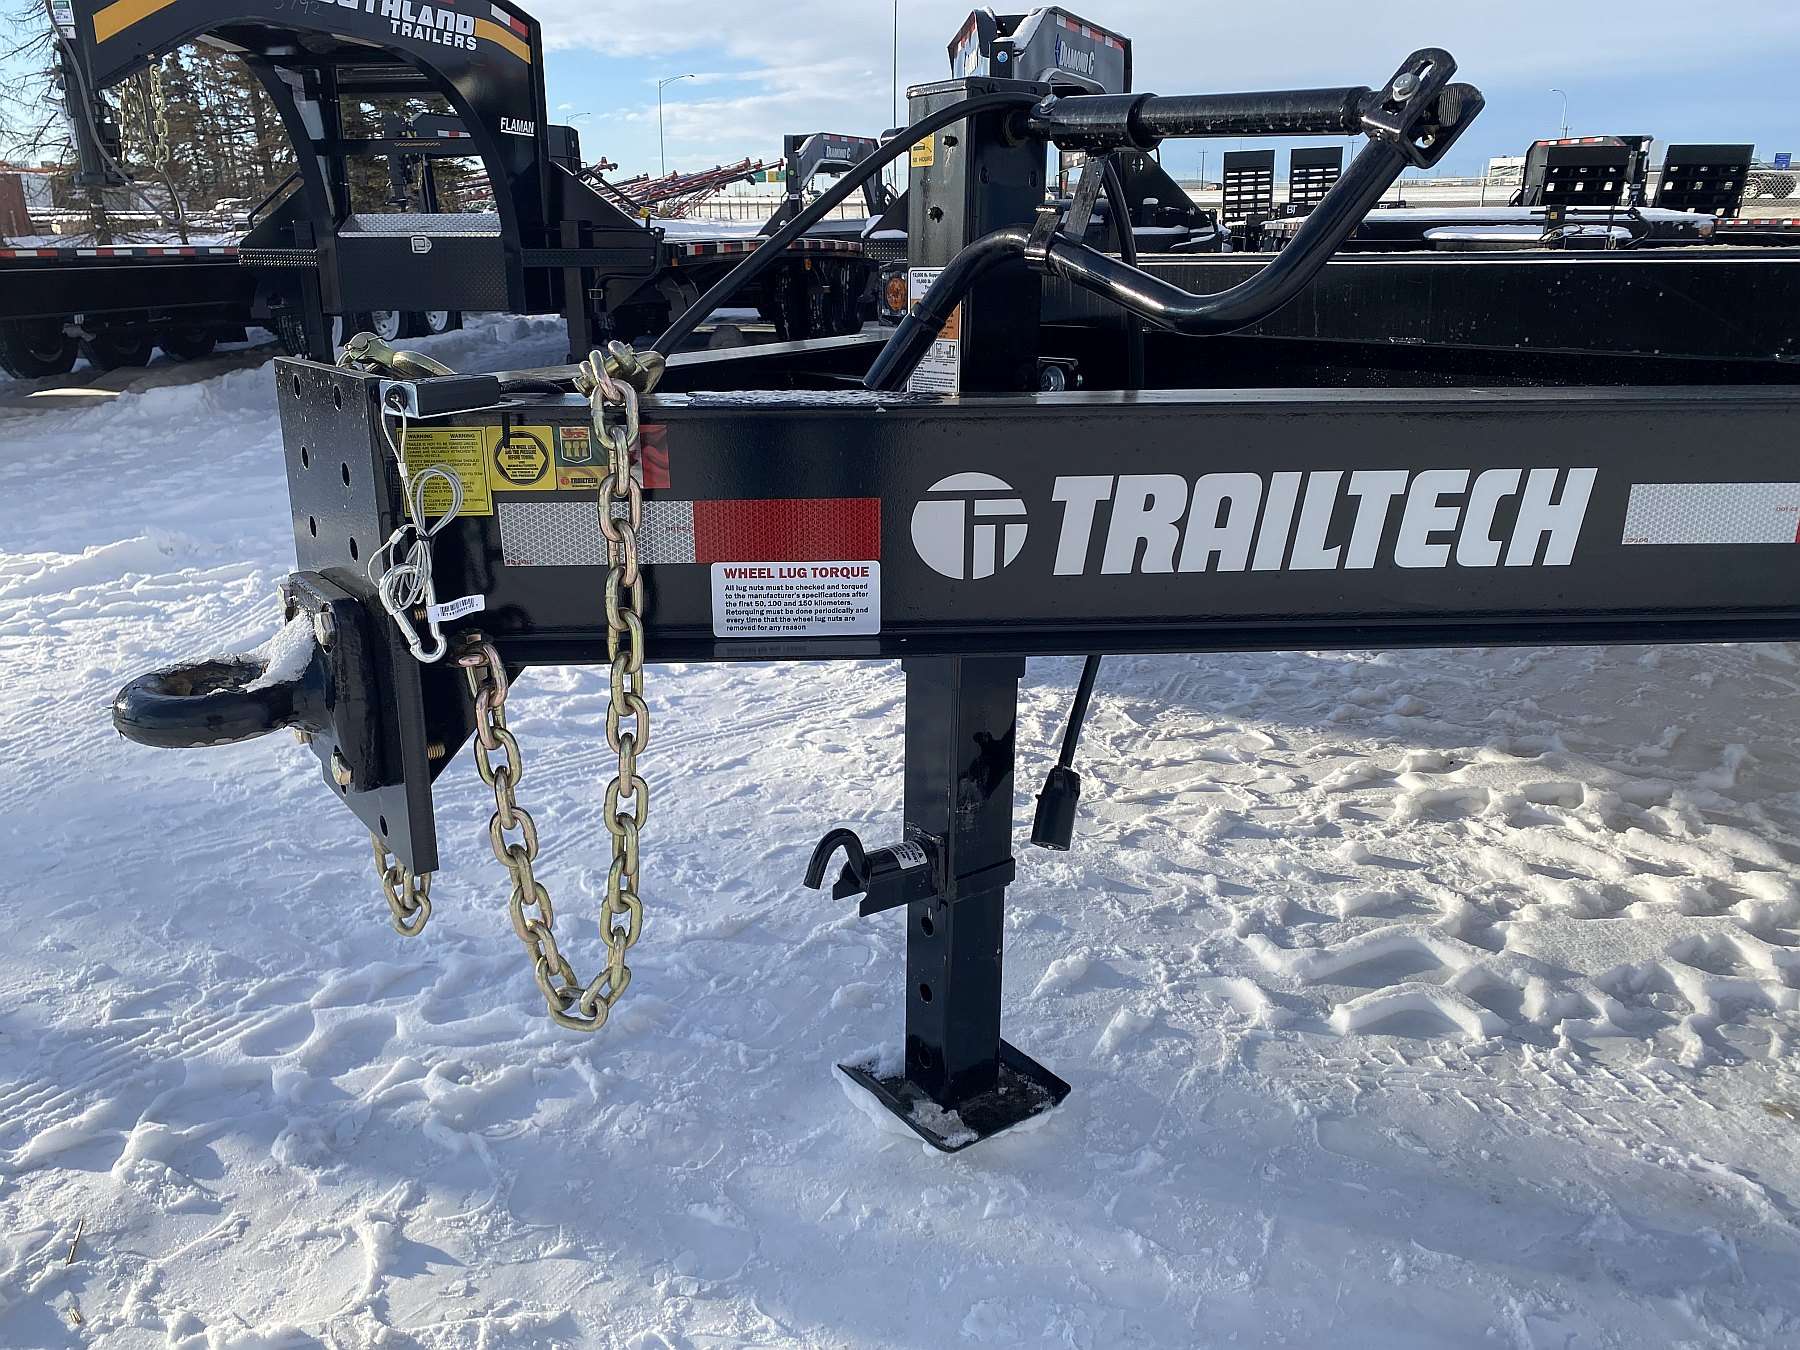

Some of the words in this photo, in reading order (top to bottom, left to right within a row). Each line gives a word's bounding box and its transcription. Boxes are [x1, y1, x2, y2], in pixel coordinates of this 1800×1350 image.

[390, 19, 477, 51] TRAILERS
[501, 117, 535, 134] FLAMAN
[1051, 467, 1598, 576] TRAILTECH
[724, 568, 775, 579] WHEEL
[779, 567, 808, 578] LUG
[811, 566, 870, 579] TORQUE
[841, 583, 868, 591] torqued
[802, 591, 850, 599] specifications
[726, 608, 764, 616] Retorquing
[814, 607, 853, 615] periodically
